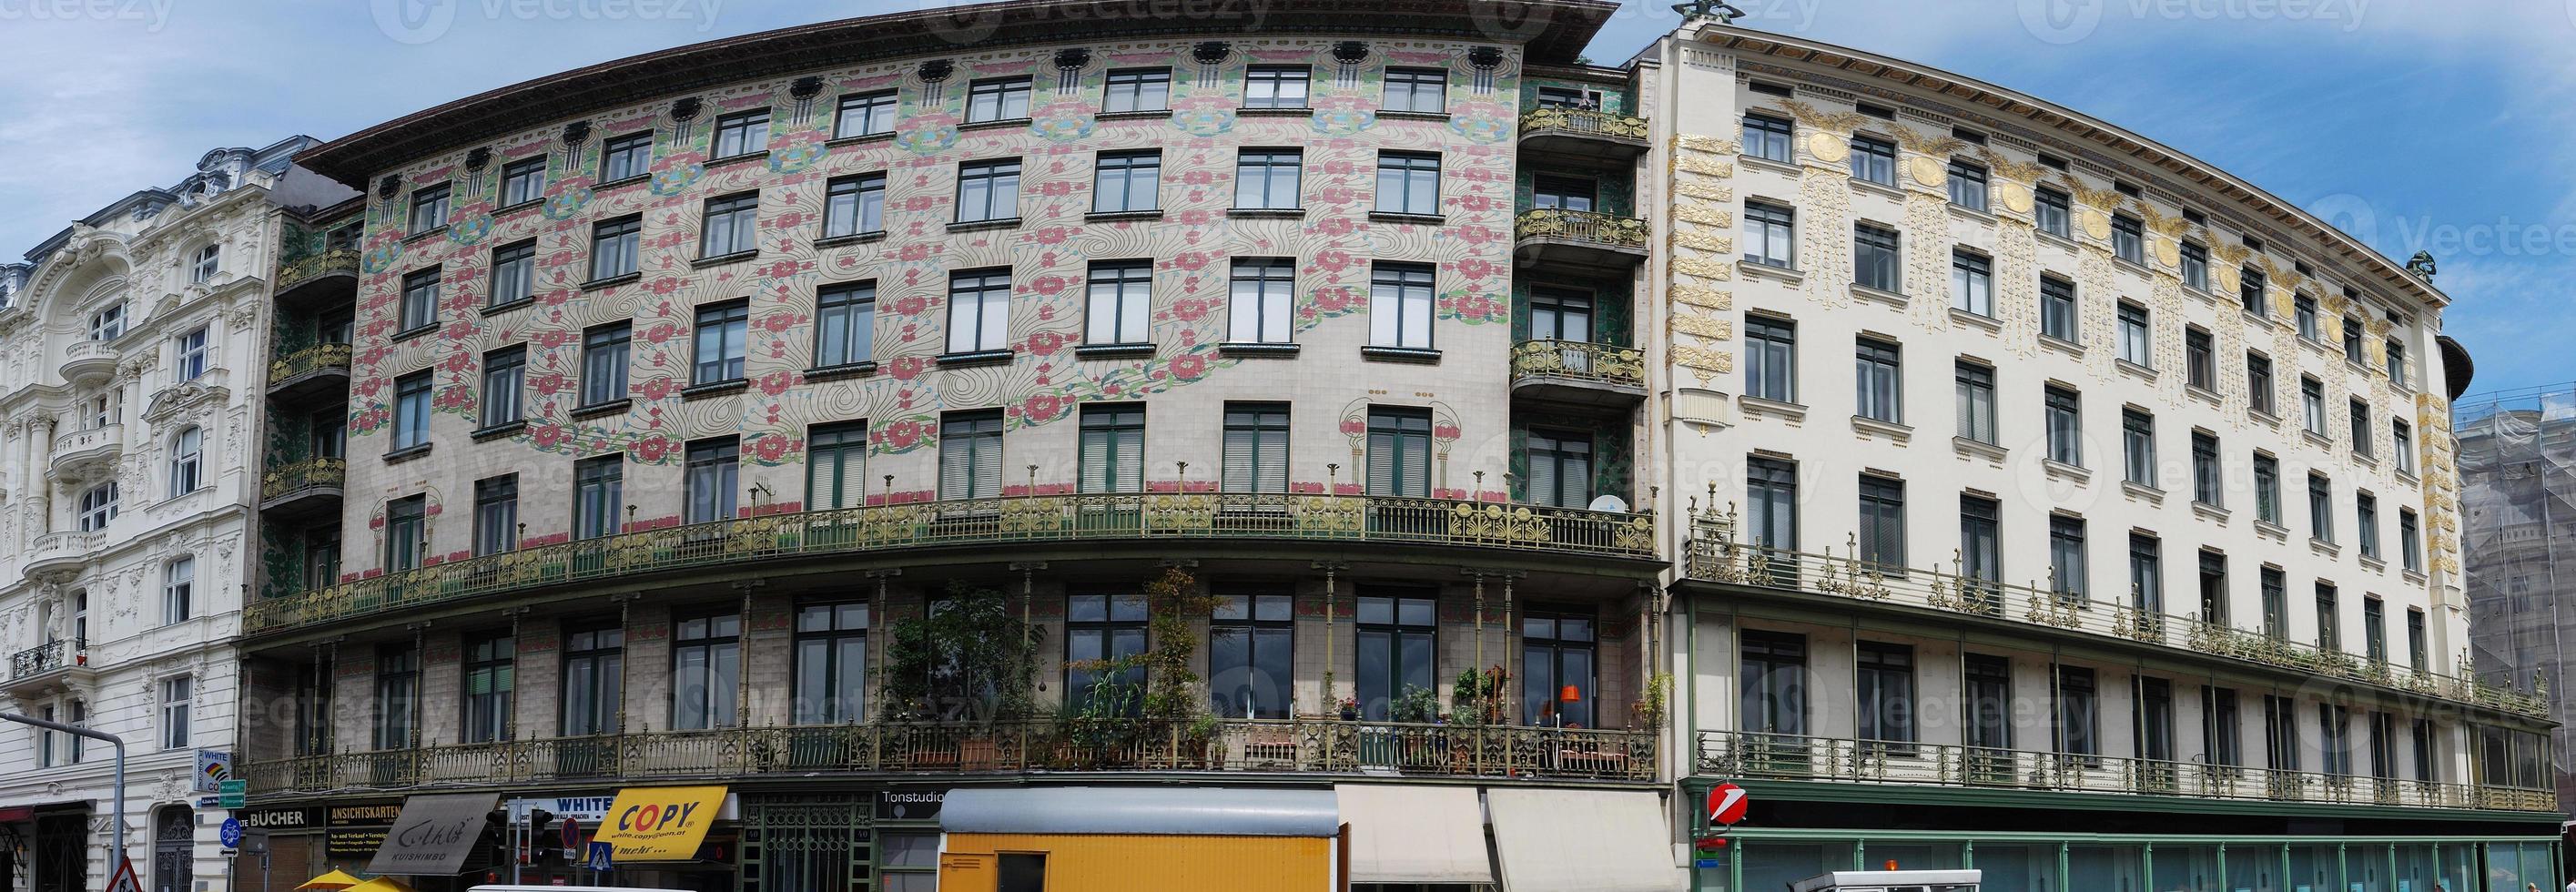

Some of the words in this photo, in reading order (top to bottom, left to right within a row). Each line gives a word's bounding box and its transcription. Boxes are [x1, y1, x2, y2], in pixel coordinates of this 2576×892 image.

[204, 751, 228, 762] WHITE
[882, 791, 945, 803] Tonstudio
[556, 798, 614, 812] WHITE
[238, 819, 248, 827] LTE
[250, 809, 305, 827] BÜCHER
[331, 806, 401, 819] ANSICHTSKARTEN
[618, 801, 701, 832] COPY
[391, 853, 447, 861] KUISHIMBO
